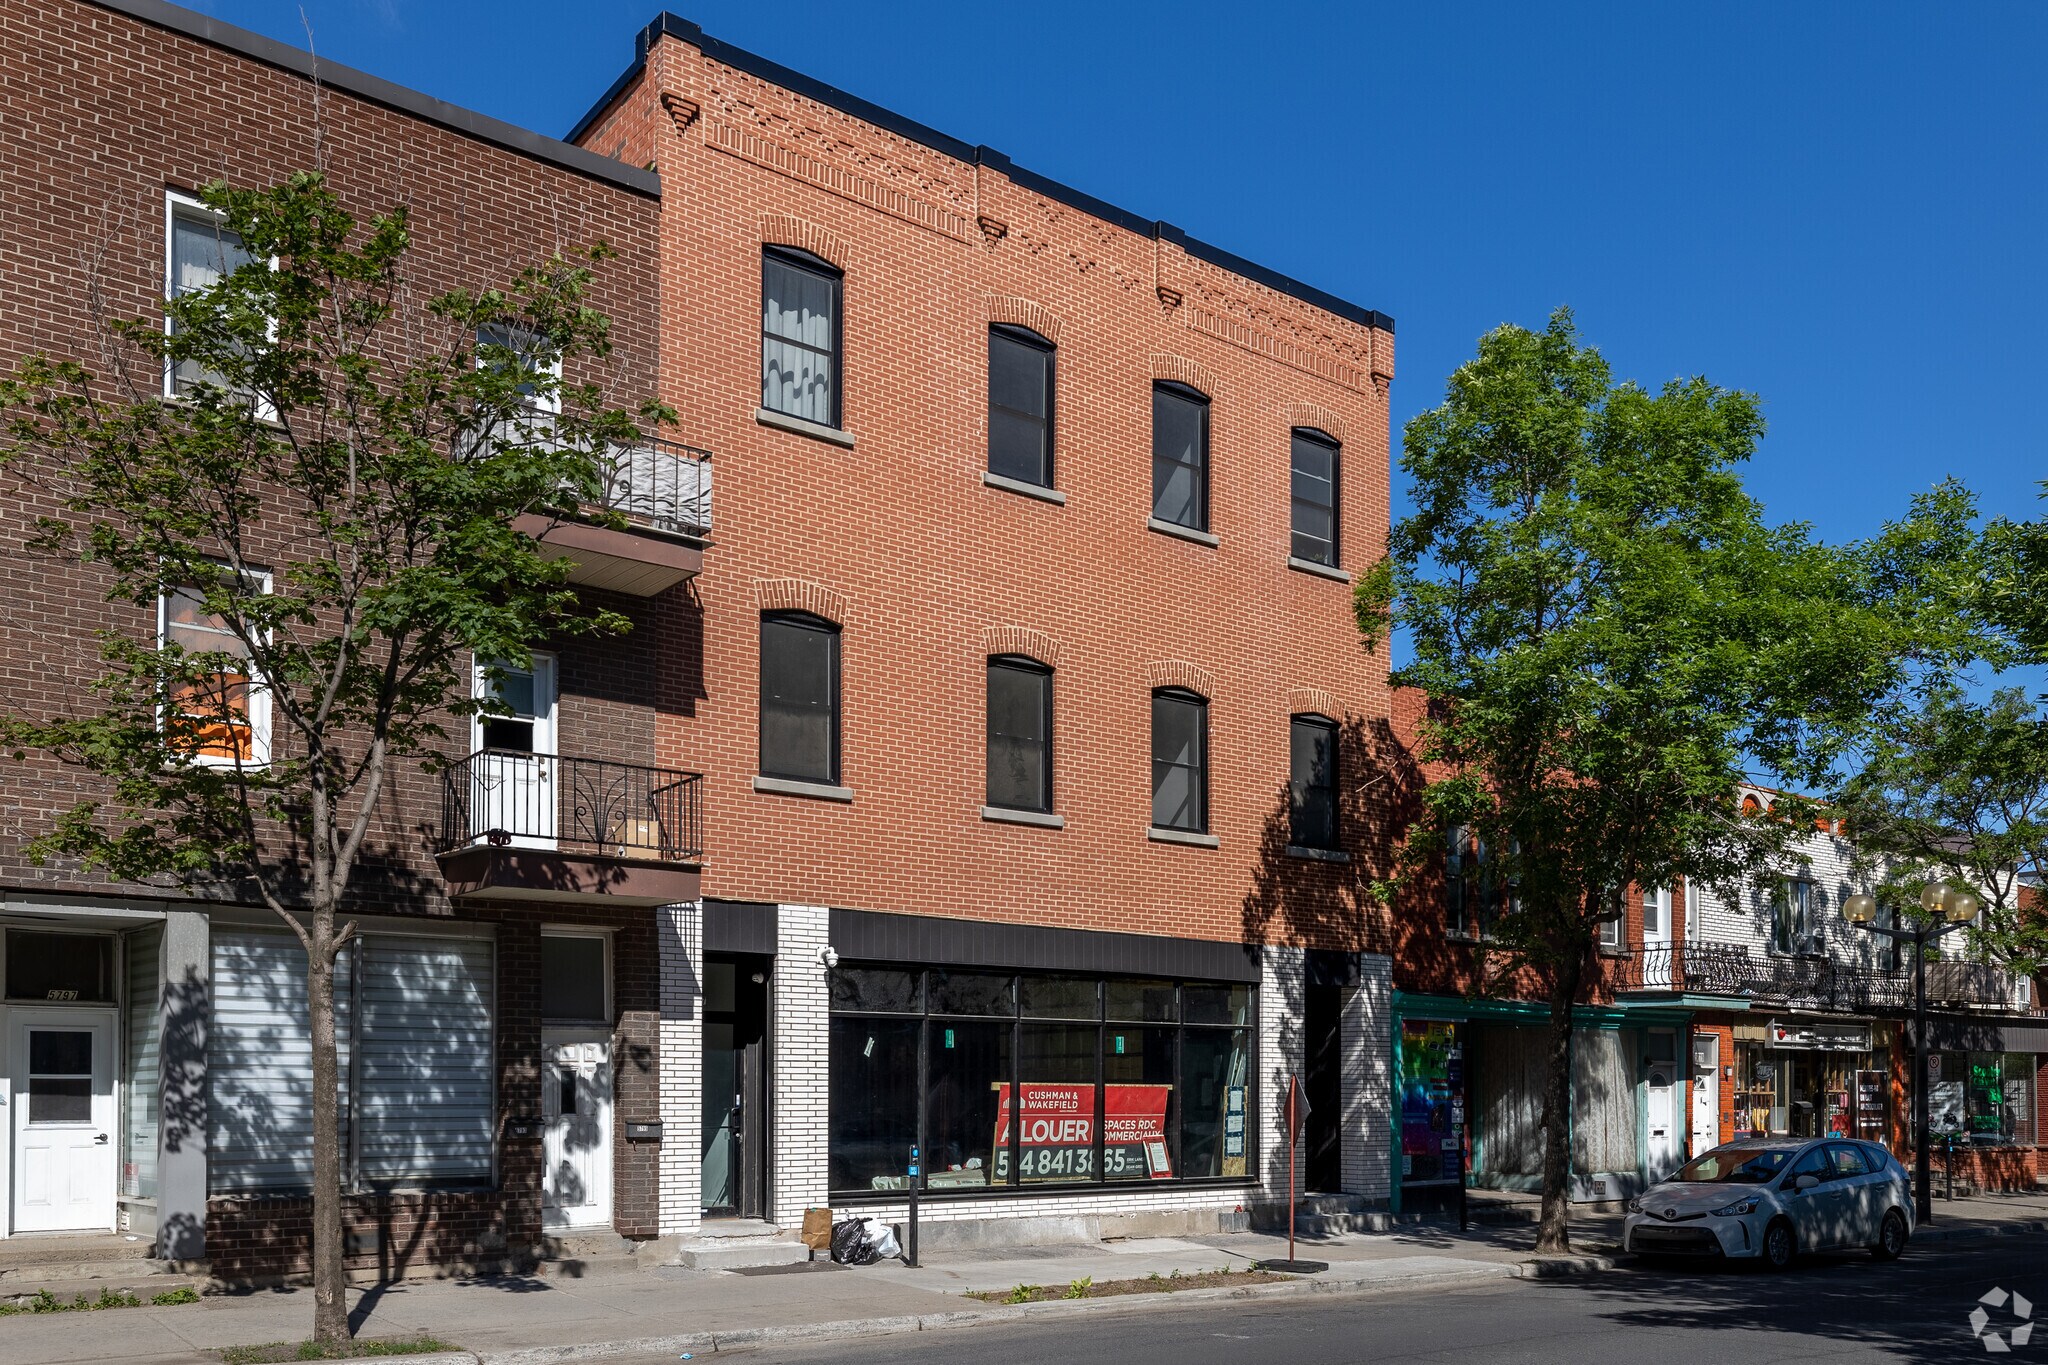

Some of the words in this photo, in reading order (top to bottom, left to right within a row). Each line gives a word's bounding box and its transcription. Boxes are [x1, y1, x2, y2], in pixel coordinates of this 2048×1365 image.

[49, 990, 77, 1000] 5797
[1028, 1091, 1071, 1100] CUSHMAN
[1072, 1091, 1079, 1100] &
[1028, 1101, 1079, 1109] WAKEFIELD
[1104, 1120, 1136, 1130] SPACES
[1138, 1120, 1156, 1130] RDC
[1021, 1120, 1089, 1142] LOUER
[1104, 1131, 1161, 1141] OMMERCIAUX
[996, 1150, 1034, 1176] 54
